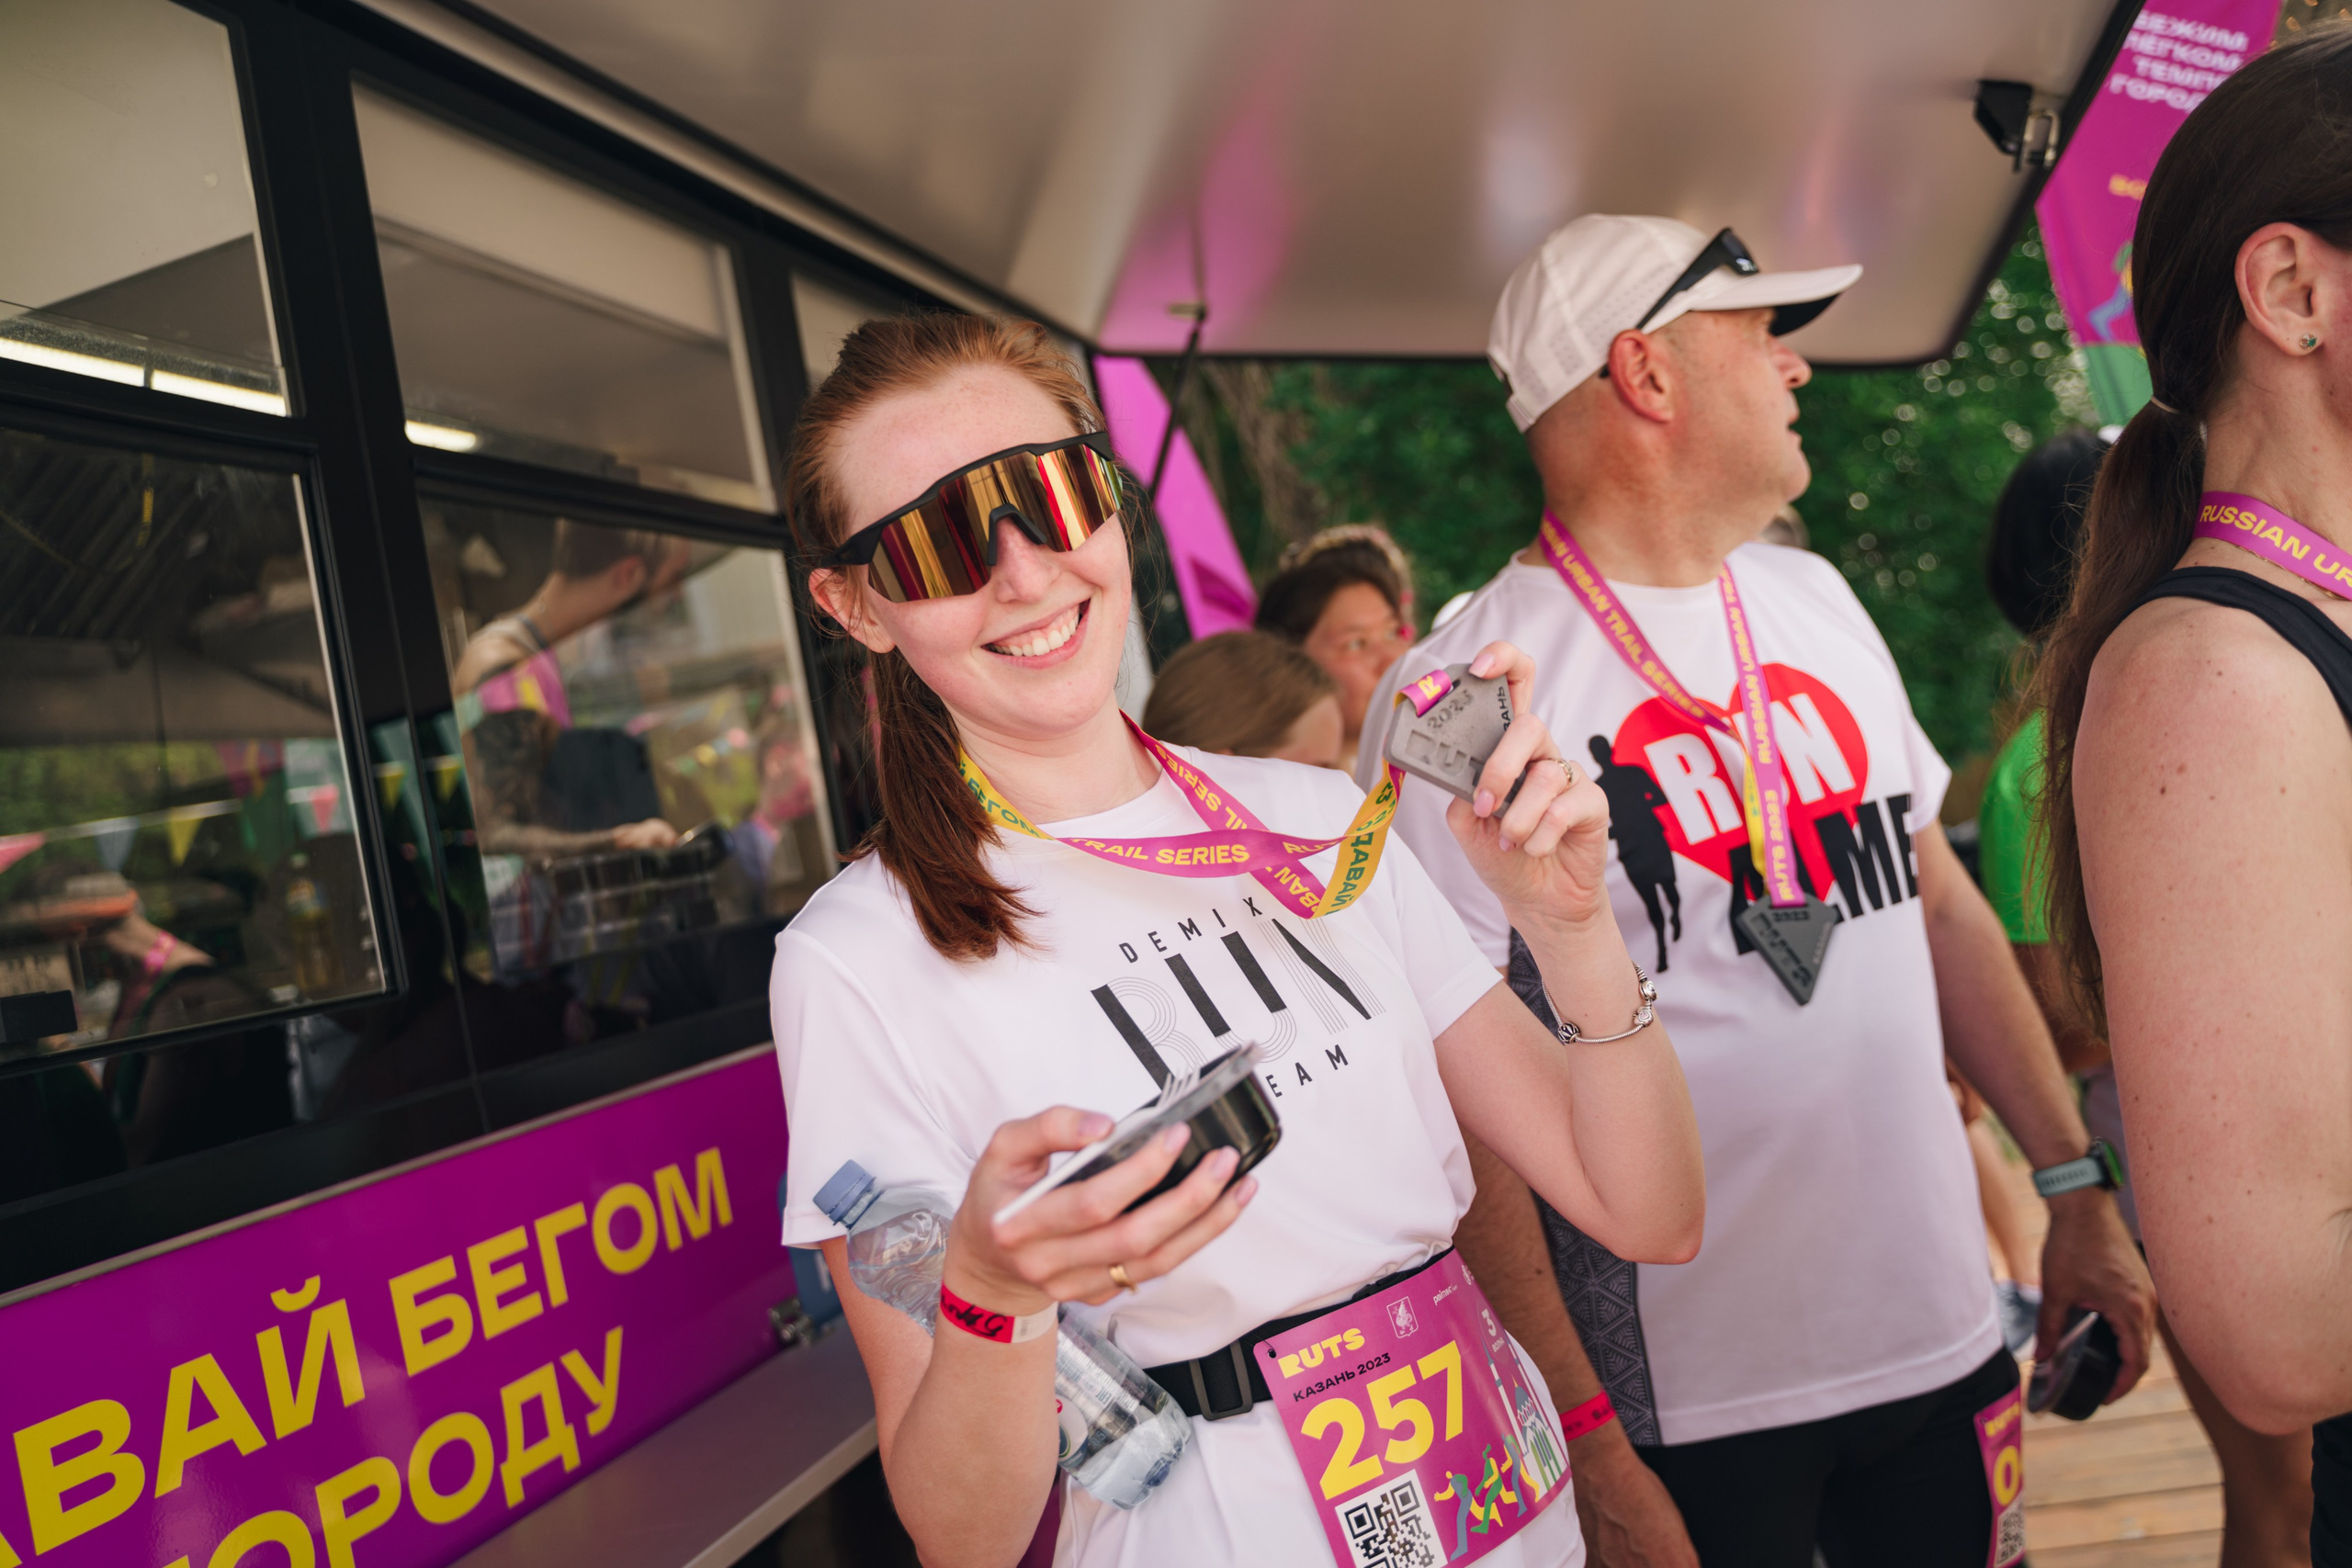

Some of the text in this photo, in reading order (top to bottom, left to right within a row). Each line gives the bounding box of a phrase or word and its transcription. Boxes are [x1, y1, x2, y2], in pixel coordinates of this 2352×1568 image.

[2199, 505, 2312, 560] RUSSIAN
[1562, 554, 1611, 613] URBAN
[1605, 609, 1644, 664] TRAIL
[1641, 660, 1706, 718] SERIES
[1728, 606, 1756, 671] URBAN
[1744, 673, 1773, 765] RUSSIAN
[1155, 744, 1222, 811] SERIES
[1155, 843, 1250, 865] SERIES
[1330, 832, 1374, 908] ДАВАЙ
[1118, 897, 1263, 964] DEMIX
[1091, 917, 1386, 1093] RUN
[1265, 1043, 1349, 1098] EAM
[1277, 1327, 1365, 1380] RUTS
[1481, 1308, 1497, 1337] 3
[0, 1145, 734, 1568] ВАЙ БЕГОМ
[1292, 1351, 1392, 1404] КАЗАНЬ 2023
[162, 1325, 624, 1568] РОДУ
[1300, 1339, 1464, 1502] 257
